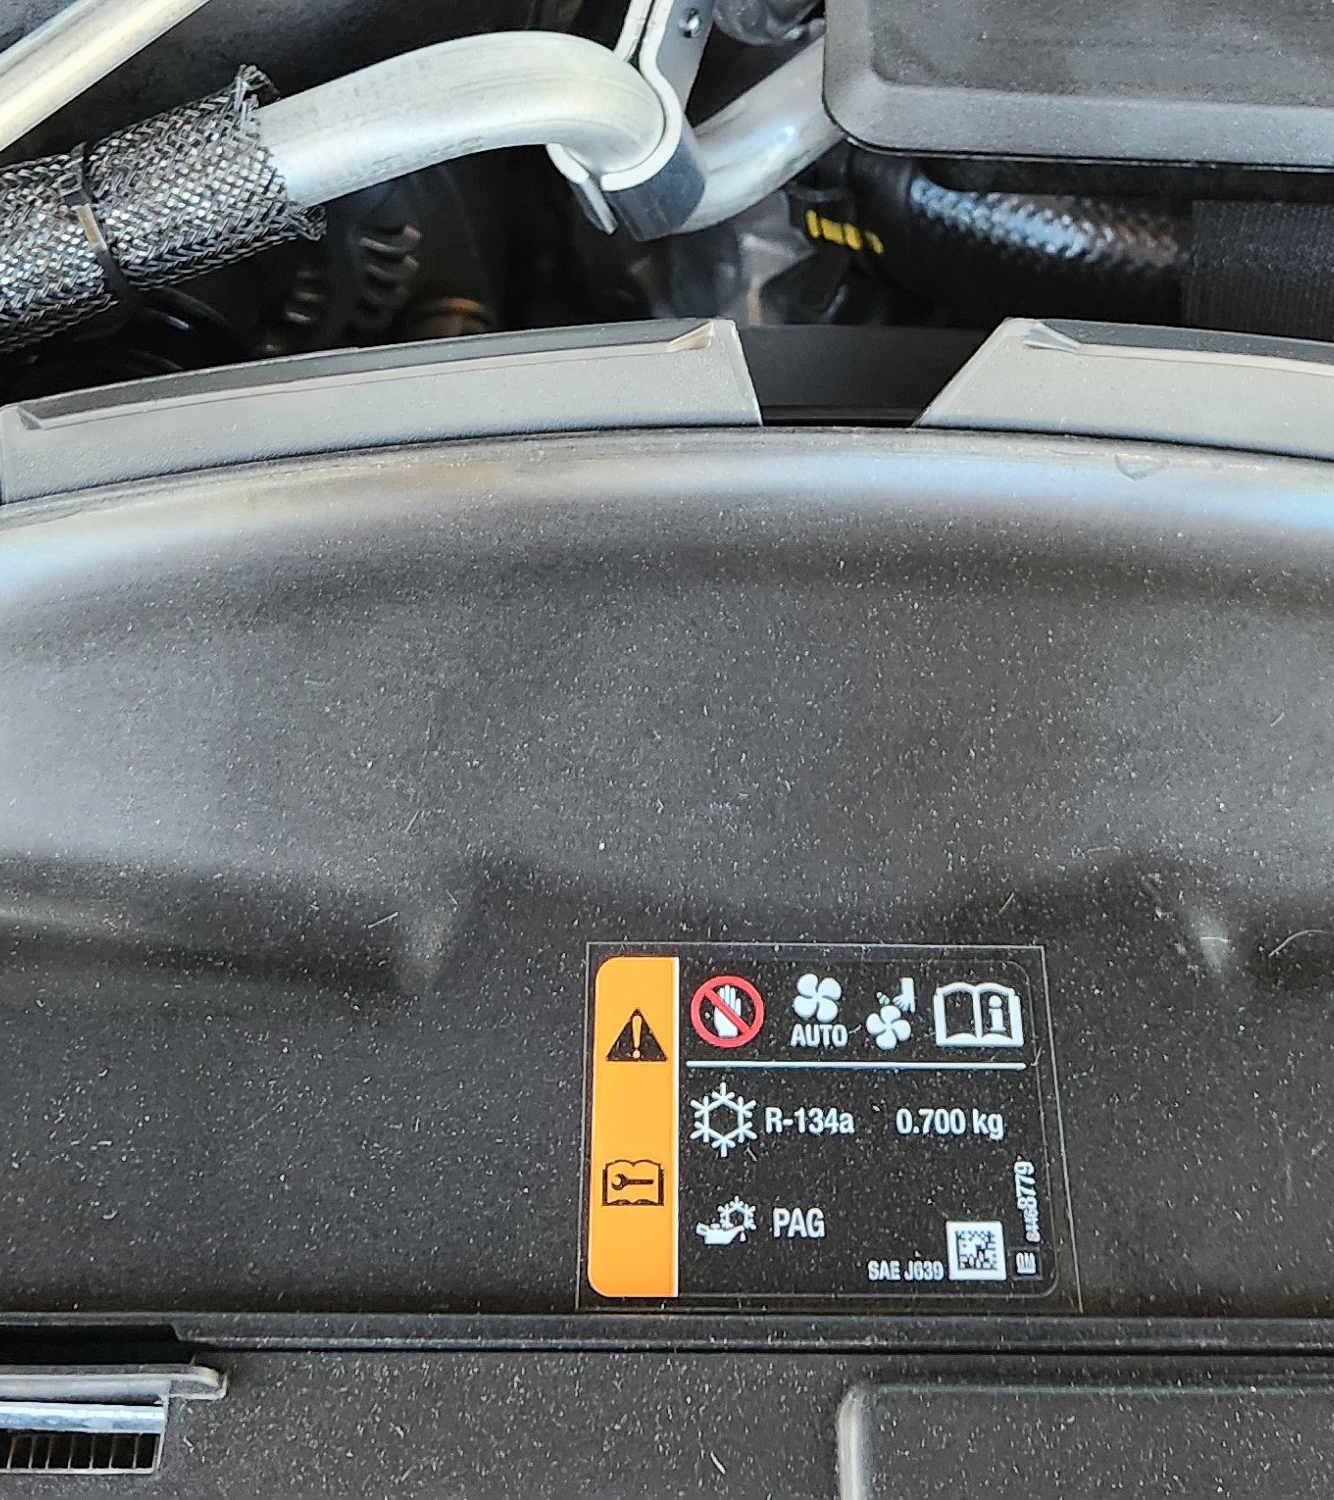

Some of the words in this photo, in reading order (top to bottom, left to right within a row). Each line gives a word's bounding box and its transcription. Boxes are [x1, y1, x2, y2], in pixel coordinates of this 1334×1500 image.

[790, 1023, 849, 1048] AUTO
[765, 1108, 855, 1135] R-134a
[895, 1108, 966, 1136] 0.700
[973, 1109, 1005, 1141] kg
[772, 1207, 826, 1238] PAG
[867, 1260, 901, 1281] SAE
[904, 1260, 945, 1281] J639
